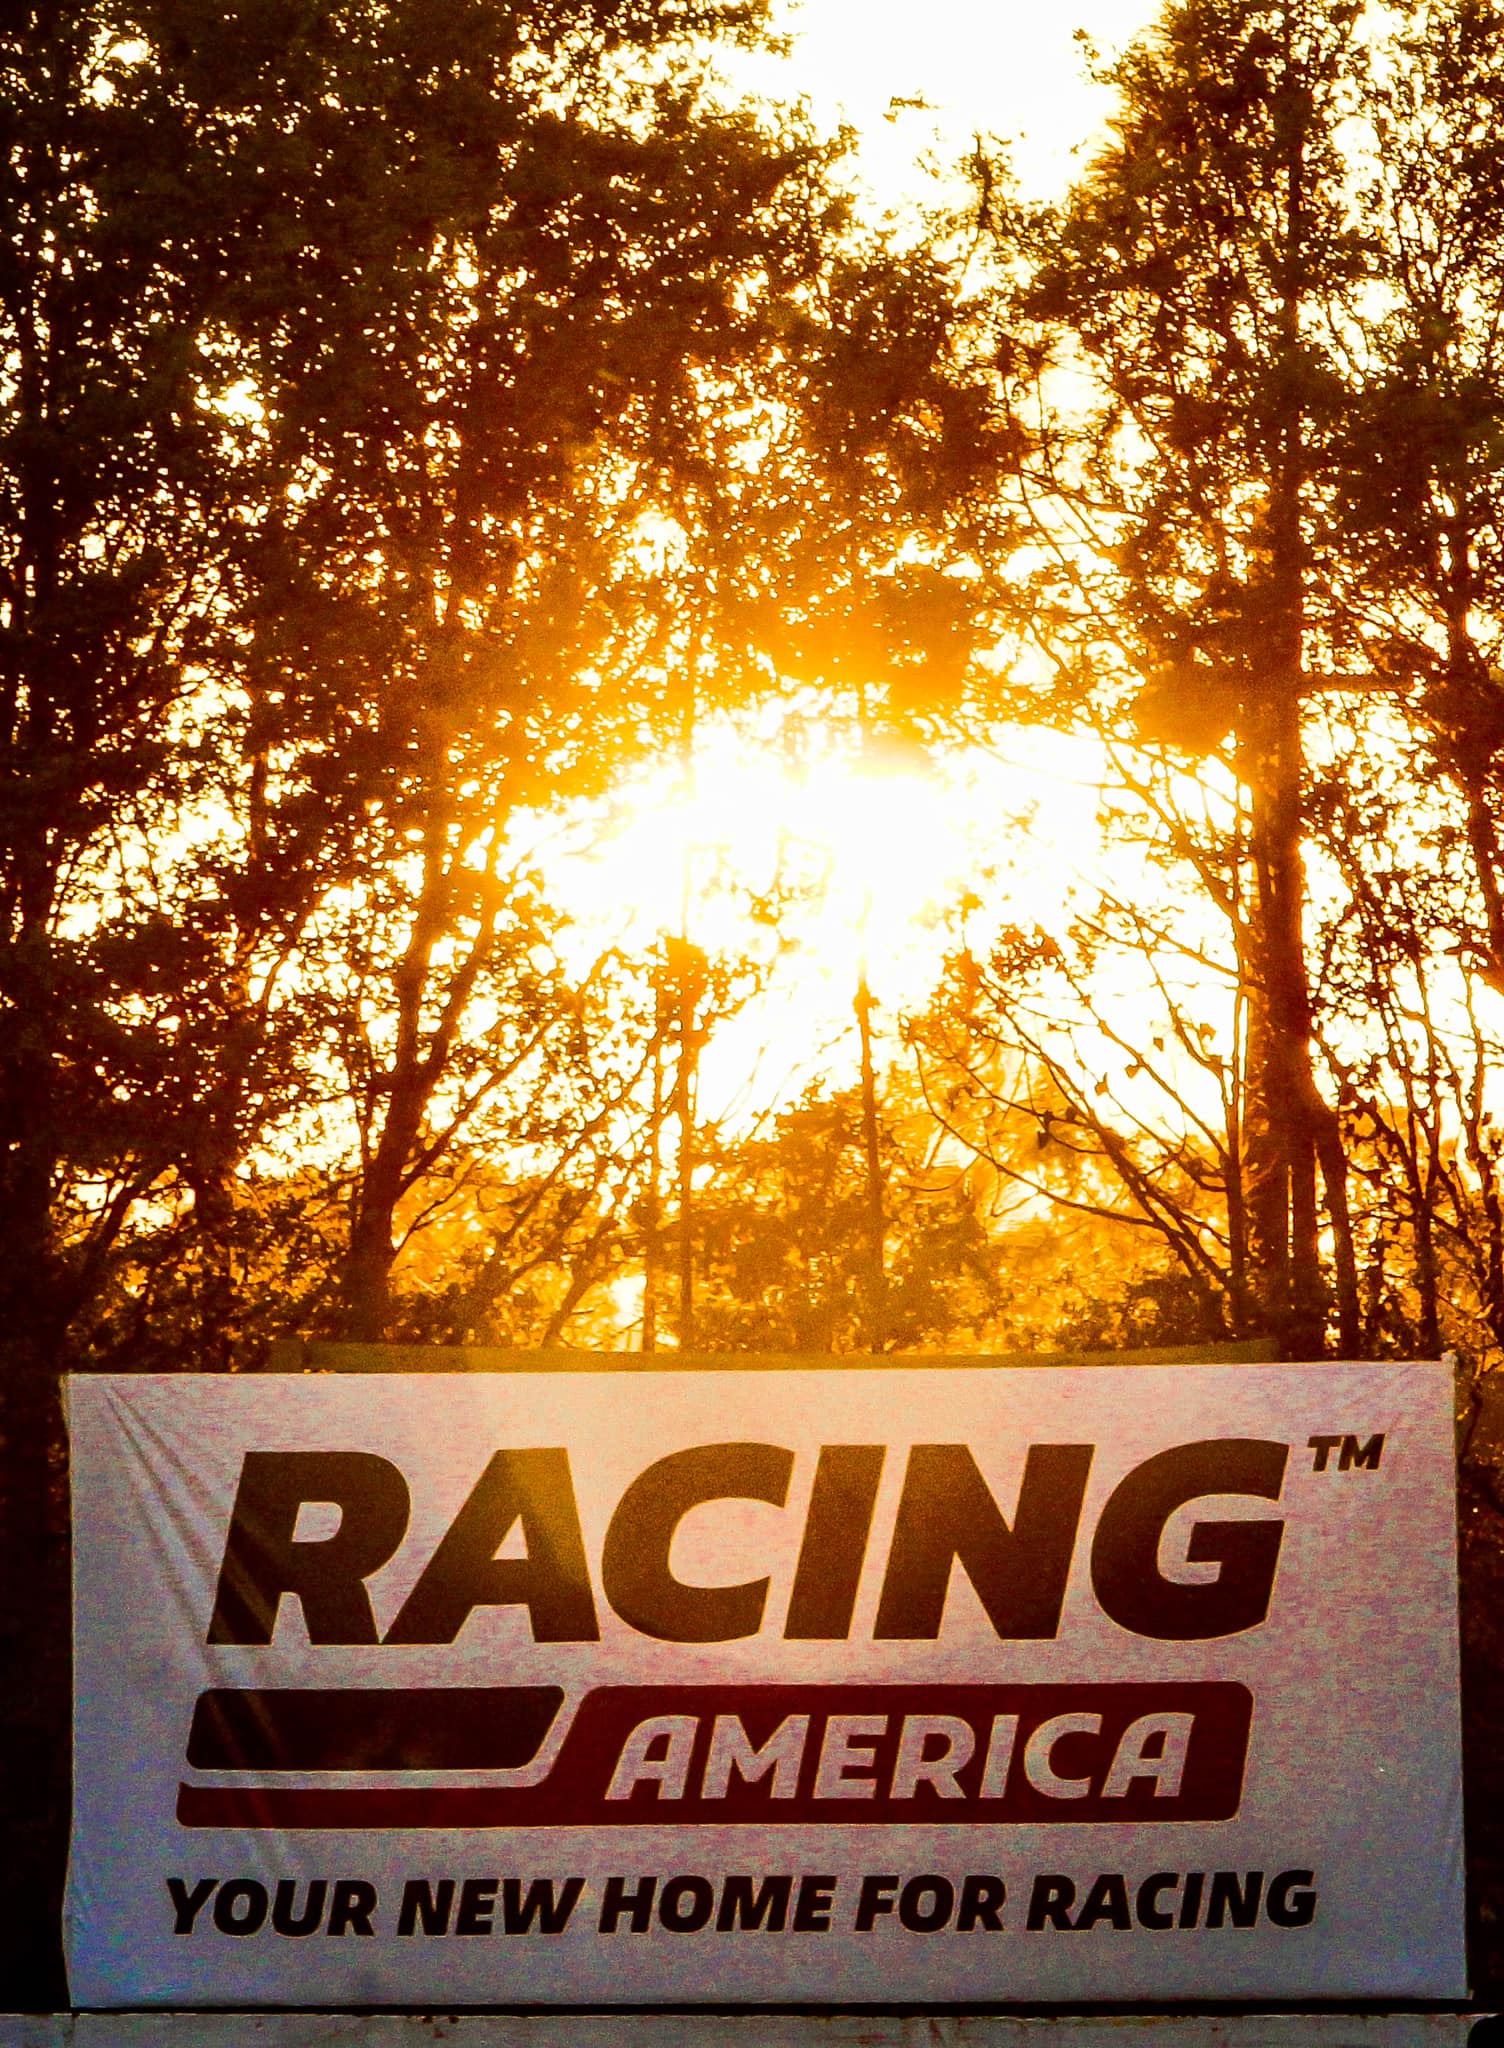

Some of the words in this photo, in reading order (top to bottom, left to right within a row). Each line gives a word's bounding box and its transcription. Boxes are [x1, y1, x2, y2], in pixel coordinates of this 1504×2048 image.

[206, 1438, 1291, 1645] RACING
[605, 1712, 1195, 1801] AMERICA
[166, 1878, 379, 1937] YOUR
[399, 1877, 586, 1937] NEW
[598, 1875, 837, 1934] HOME
[854, 1874, 1007, 1933] FOR
[1025, 1870, 1317, 1932] RACING
